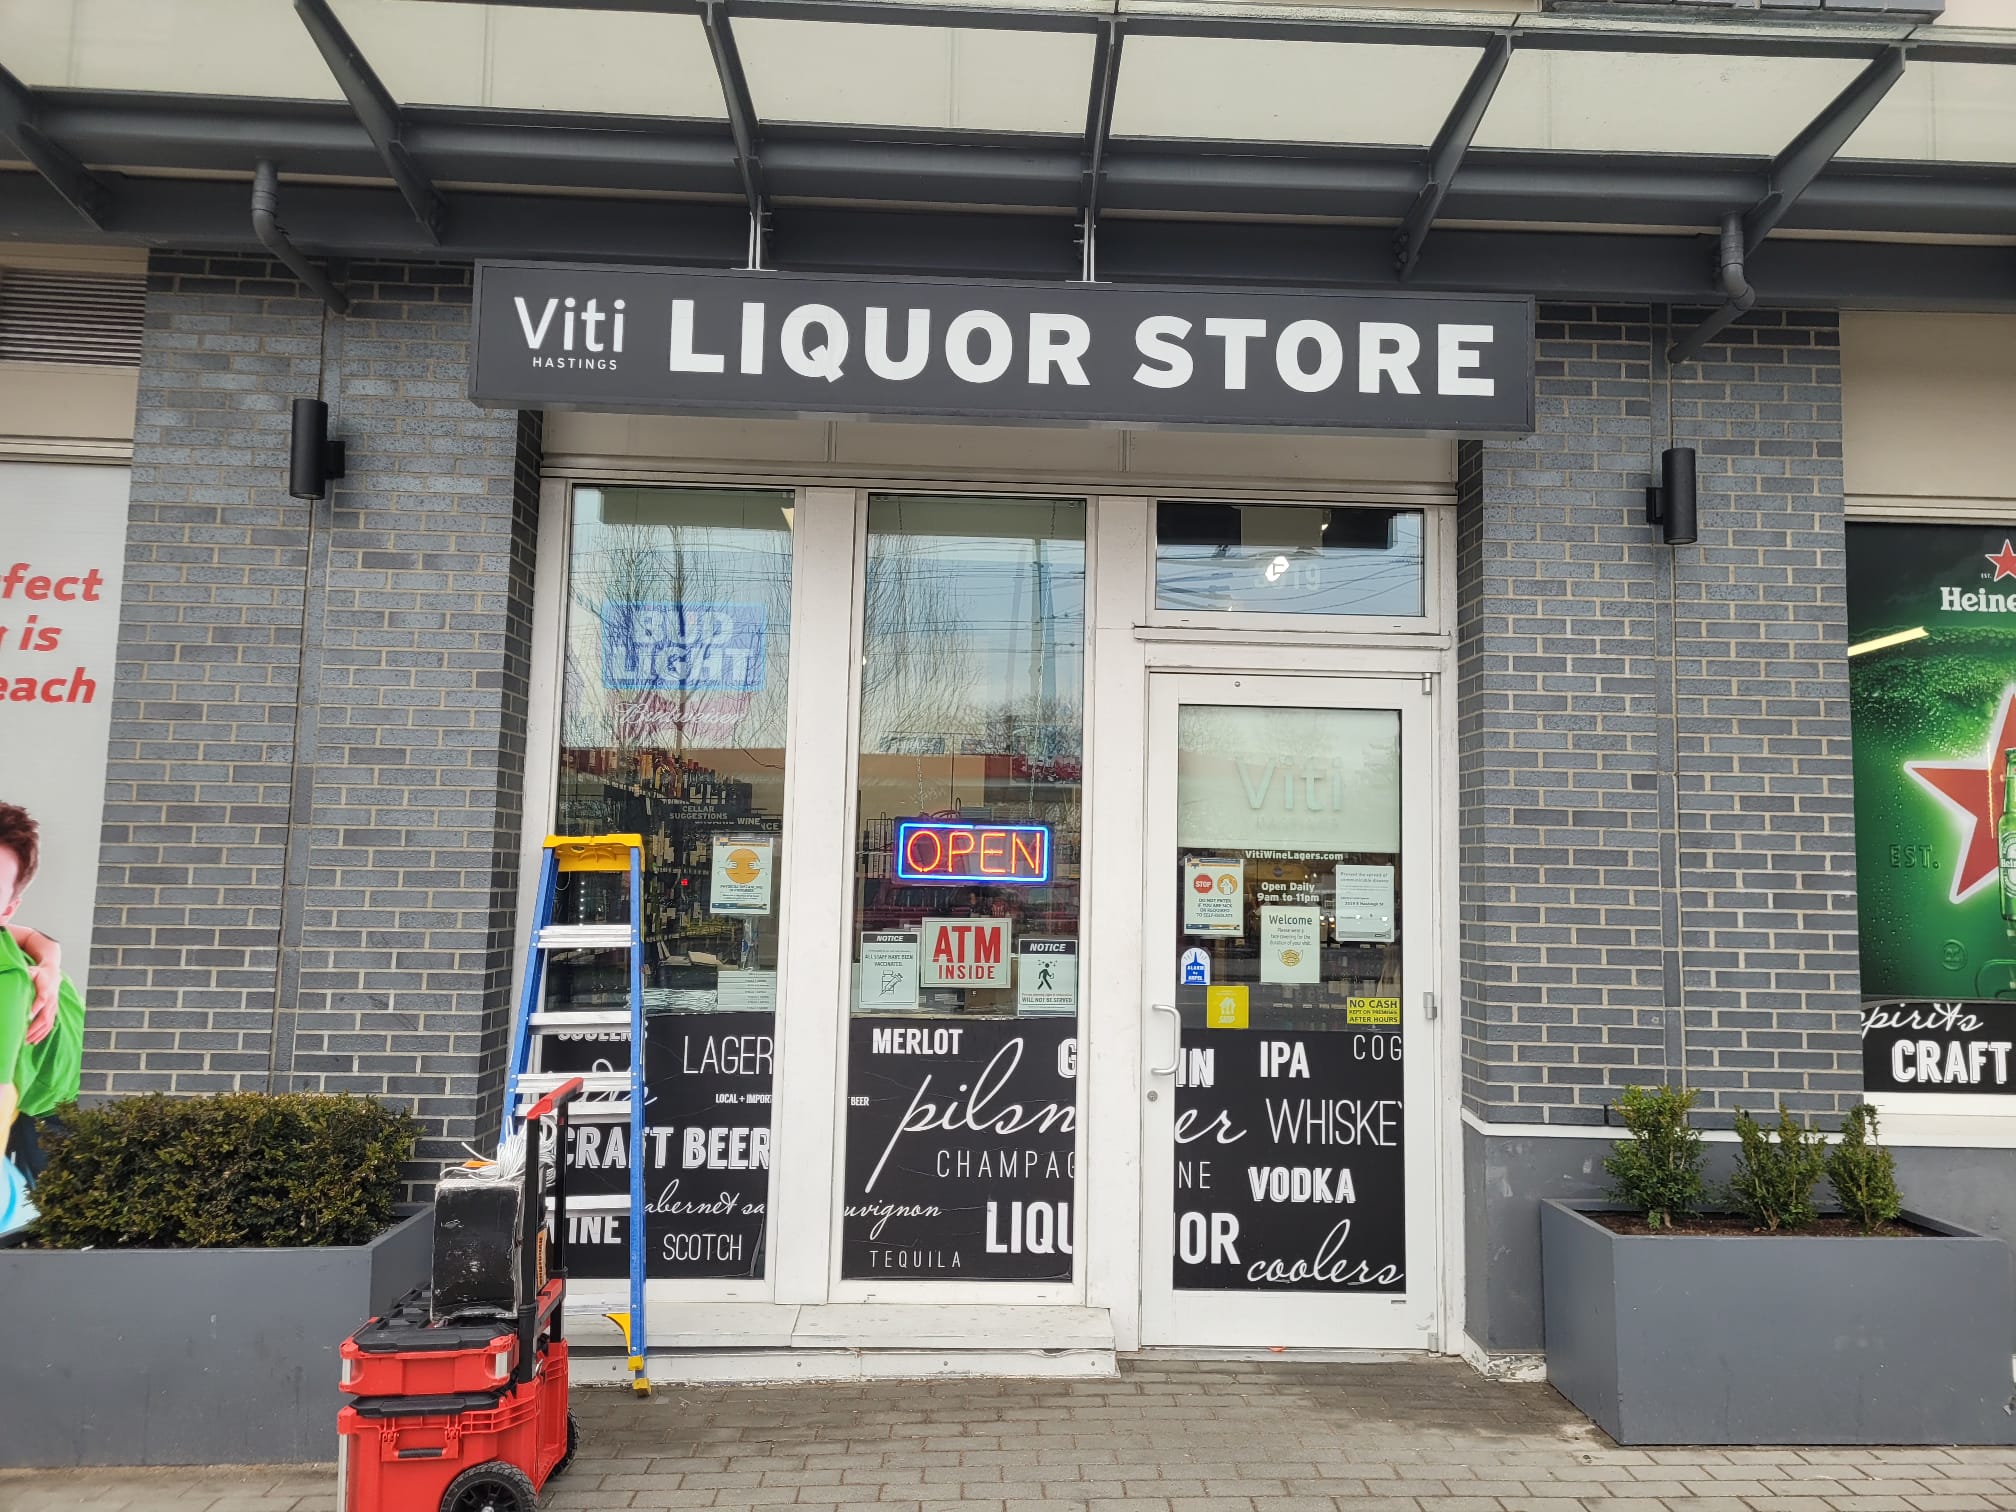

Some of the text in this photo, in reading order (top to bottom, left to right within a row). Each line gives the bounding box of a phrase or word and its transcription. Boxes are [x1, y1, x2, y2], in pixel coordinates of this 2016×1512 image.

[515, 296, 625, 352] Viti
[533, 356, 617, 371] HASTINGS
[670, 299, 1495, 397] LIQUOR STORE
[18, 614, 63, 652] is
[631, 610, 734, 645] BUD
[611, 648, 749, 681] LIGHT
[1235, 756, 1345, 811] Viti
[907, 830, 1041, 875] OPEN
[1245, 850, 1343, 861] VitiWineLagers.com
[1889, 844, 1941, 869] EST.
[1195, 880, 1211, 888] STOP
[1257, 893, 1320, 903] 9am to 11pm
[1261, 882, 1315, 892] Open Daily
[1269, 914, 1313, 925] Welcome
[932, 925, 1001, 964] ATM
[1029, 943, 1067, 952] NOTICE
[938, 964, 996, 980] INSIDE
[1349, 1000, 1398, 1008] NO CASH
[683, 1035, 773, 1075] LAGER
[872, 1028, 963, 1055] MERLOT
[1259, 1040, 1311, 1078] IPA
[1353, 1034, 1402, 1061] COG
[1175, 1048, 1215, 1088] IN
[1892, 1039, 2012, 1085] CRAFT
[715, 1093, 738, 1104] LOCAL
[850, 1096, 869, 1106] BEER
[1174, 1108, 1248, 1144] er
[1265, 1098, 1403, 1146] WHISKE
[682, 1127, 771, 1170] BEER
[1178, 1161, 1211, 1189] NE
[1248, 1166, 1356, 1204] VODKA
[643, 1178, 740, 1215] abernet
[843, 1200, 943, 1240] uvignon
[662, 1233, 742, 1261] SCOTCH
[1174, 1211, 1241, 1265] OR
[1247, 1218, 1404, 1285] coolers
[869, 1250, 961, 1268] TEQUILA
